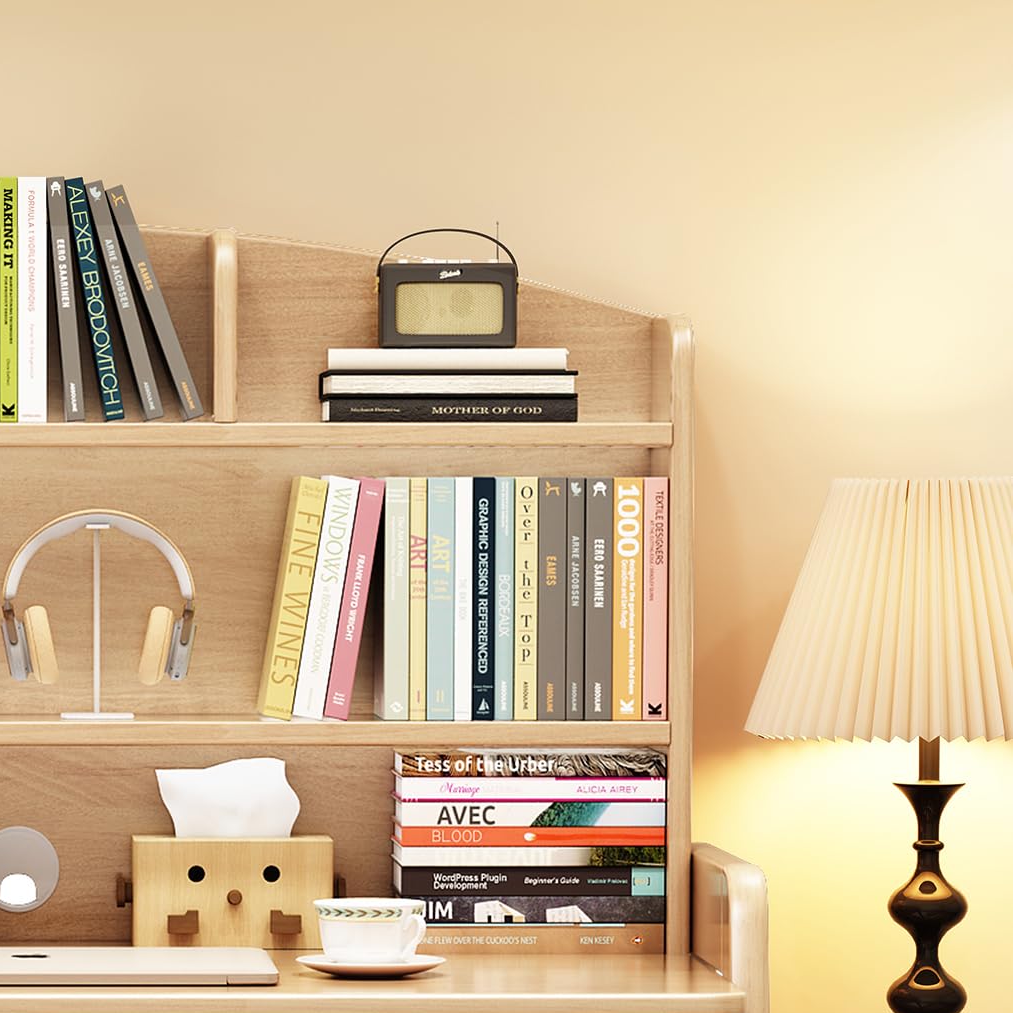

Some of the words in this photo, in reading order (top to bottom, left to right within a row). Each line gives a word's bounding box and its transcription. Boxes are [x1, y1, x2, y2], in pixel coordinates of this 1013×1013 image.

[3, 188, 14, 250] MAKING
[27, 190, 35, 228] FORMULA
[3, 253, 14, 269] IT
[27, 236, 35, 265] WORLD
[56, 239, 67, 261] EERO
[27, 266, 35, 312] CHAMPIONS
[59, 264, 71, 308] SAARINEN
[105, 239, 117, 262] ARNE
[111, 264, 131, 309] JACOBSEN
[137, 261, 154, 292] EAMES
[67, 185, 96, 264] ALEXEY
[83, 270, 121, 405] BRODOVITCH
[431, 406, 488, 415] MOTHER
[491, 406, 510, 415] OF
[513, 406, 543, 415] GOD
[478, 497, 489, 550] GRAPHIC
[521, 485, 533, 542] Over
[617, 484, 640, 558] 1000
[655, 490, 665, 521] TEXTILE
[288, 510, 321, 578] FINE
[320, 487, 353, 584] WINDOWS
[411, 534, 427, 573] ART
[571, 535, 580, 559] ARNE
[594, 538, 605, 561] EERO
[655, 522, 665, 566] DESIGNERS
[353, 553, 366, 582] FRANK
[432, 534, 450, 574] ART
[546, 555, 557, 586] EAMES
[478, 553, 489, 596] DESIGN
[521, 560, 531, 600] the
[571, 560, 580, 607] JACOBSEN
[593, 563, 605, 608] SAARINEN
[349, 581, 363, 609] LLOYD
[499, 574, 511, 638] BORDEAUX
[271, 590, 309, 687] WINES
[345, 608, 358, 643] WRIGHT
[477, 598, 489, 674] REFERENCED
[520, 614, 533, 662] Top
[415, 756, 451, 772] Tess
[455, 756, 473, 772] of
[476, 756, 504, 772] the
[508, 756, 555, 772] Urber
[440, 782, 481, 797] Marriage
[576, 786, 607, 794] ALICIA
[609, 786, 639, 794] AIREY
[437, 805, 496, 826] AVEC
[431, 830, 483, 843] BLOOD
[433, 873, 479, 882] WordPress
[481, 873, 507, 885] Plugin
[433, 882, 488, 891] Development
[524, 876, 559, 886] Beginner's
[560, 876, 580, 885] Guide
[435, 936, 453, 945] FLEW
[453, 936, 471, 945] OVER
[471, 936, 484, 945] THE
[485, 936, 519, 945] CUCKOO'S
[520, 936, 537, 945] NEST
[580, 936, 592, 945] KEN
[593, 936, 615, 945] KESEY
